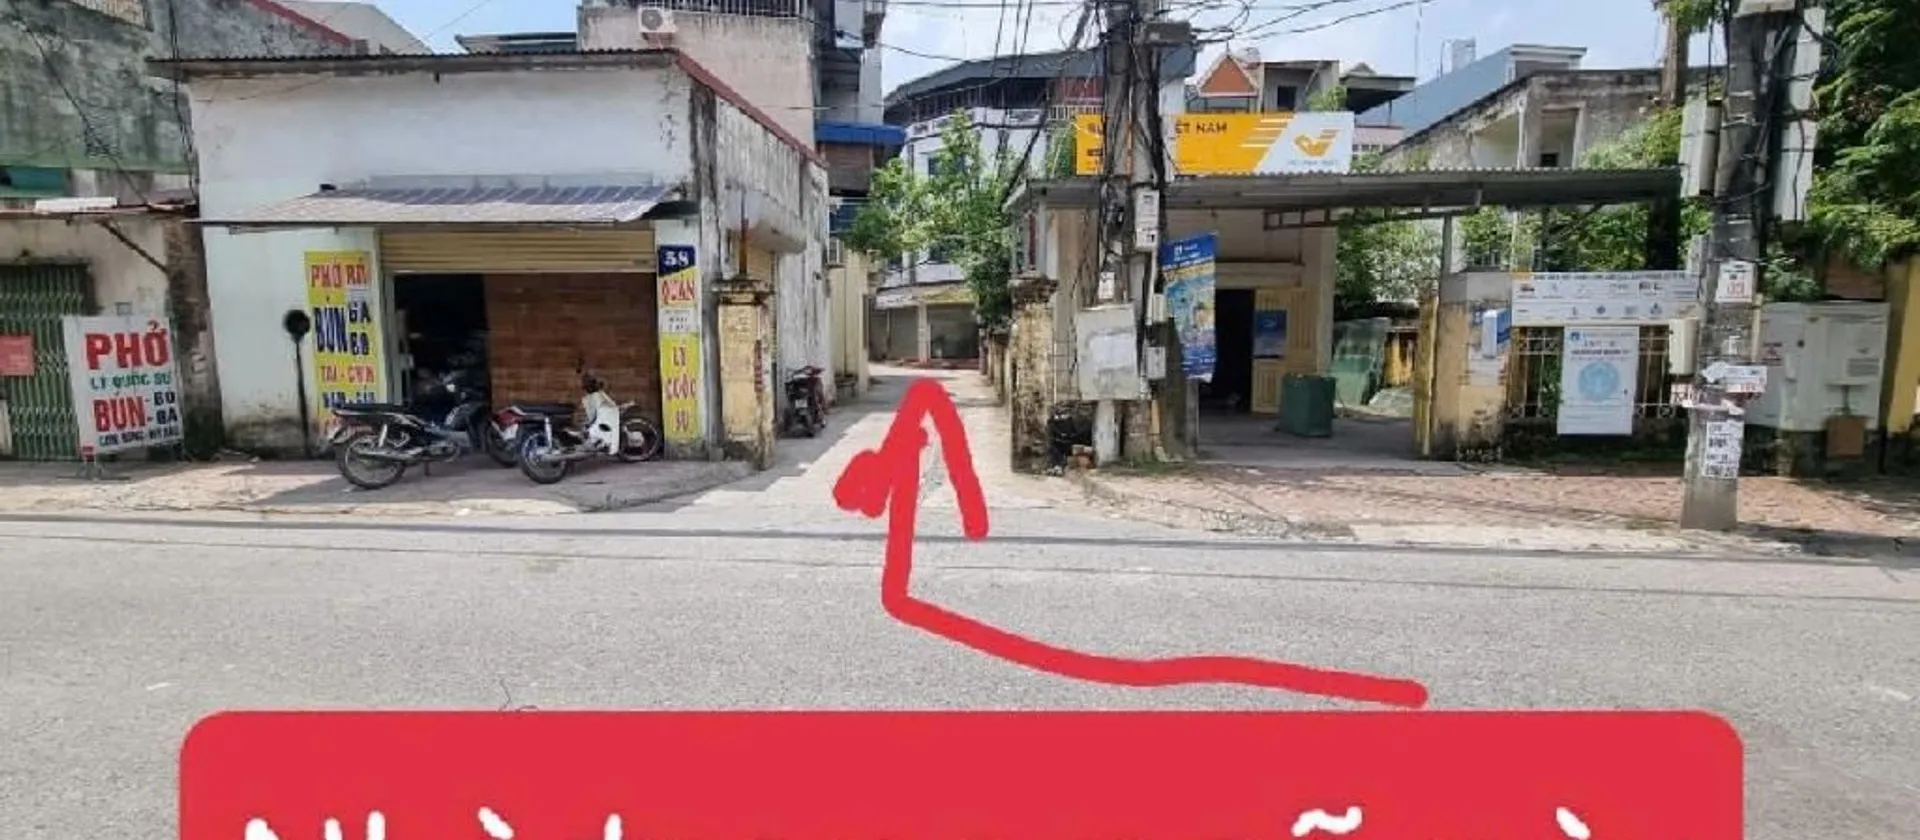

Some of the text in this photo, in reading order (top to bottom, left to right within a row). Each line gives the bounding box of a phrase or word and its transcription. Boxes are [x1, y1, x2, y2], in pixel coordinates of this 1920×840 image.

[1196, 121, 1227, 134] NAM
[664, 250, 690, 267] 58
[85, 320, 168, 370] PHỞ
[313, 296, 348, 353] BÚN
[93, 391, 146, 432] BÚN
